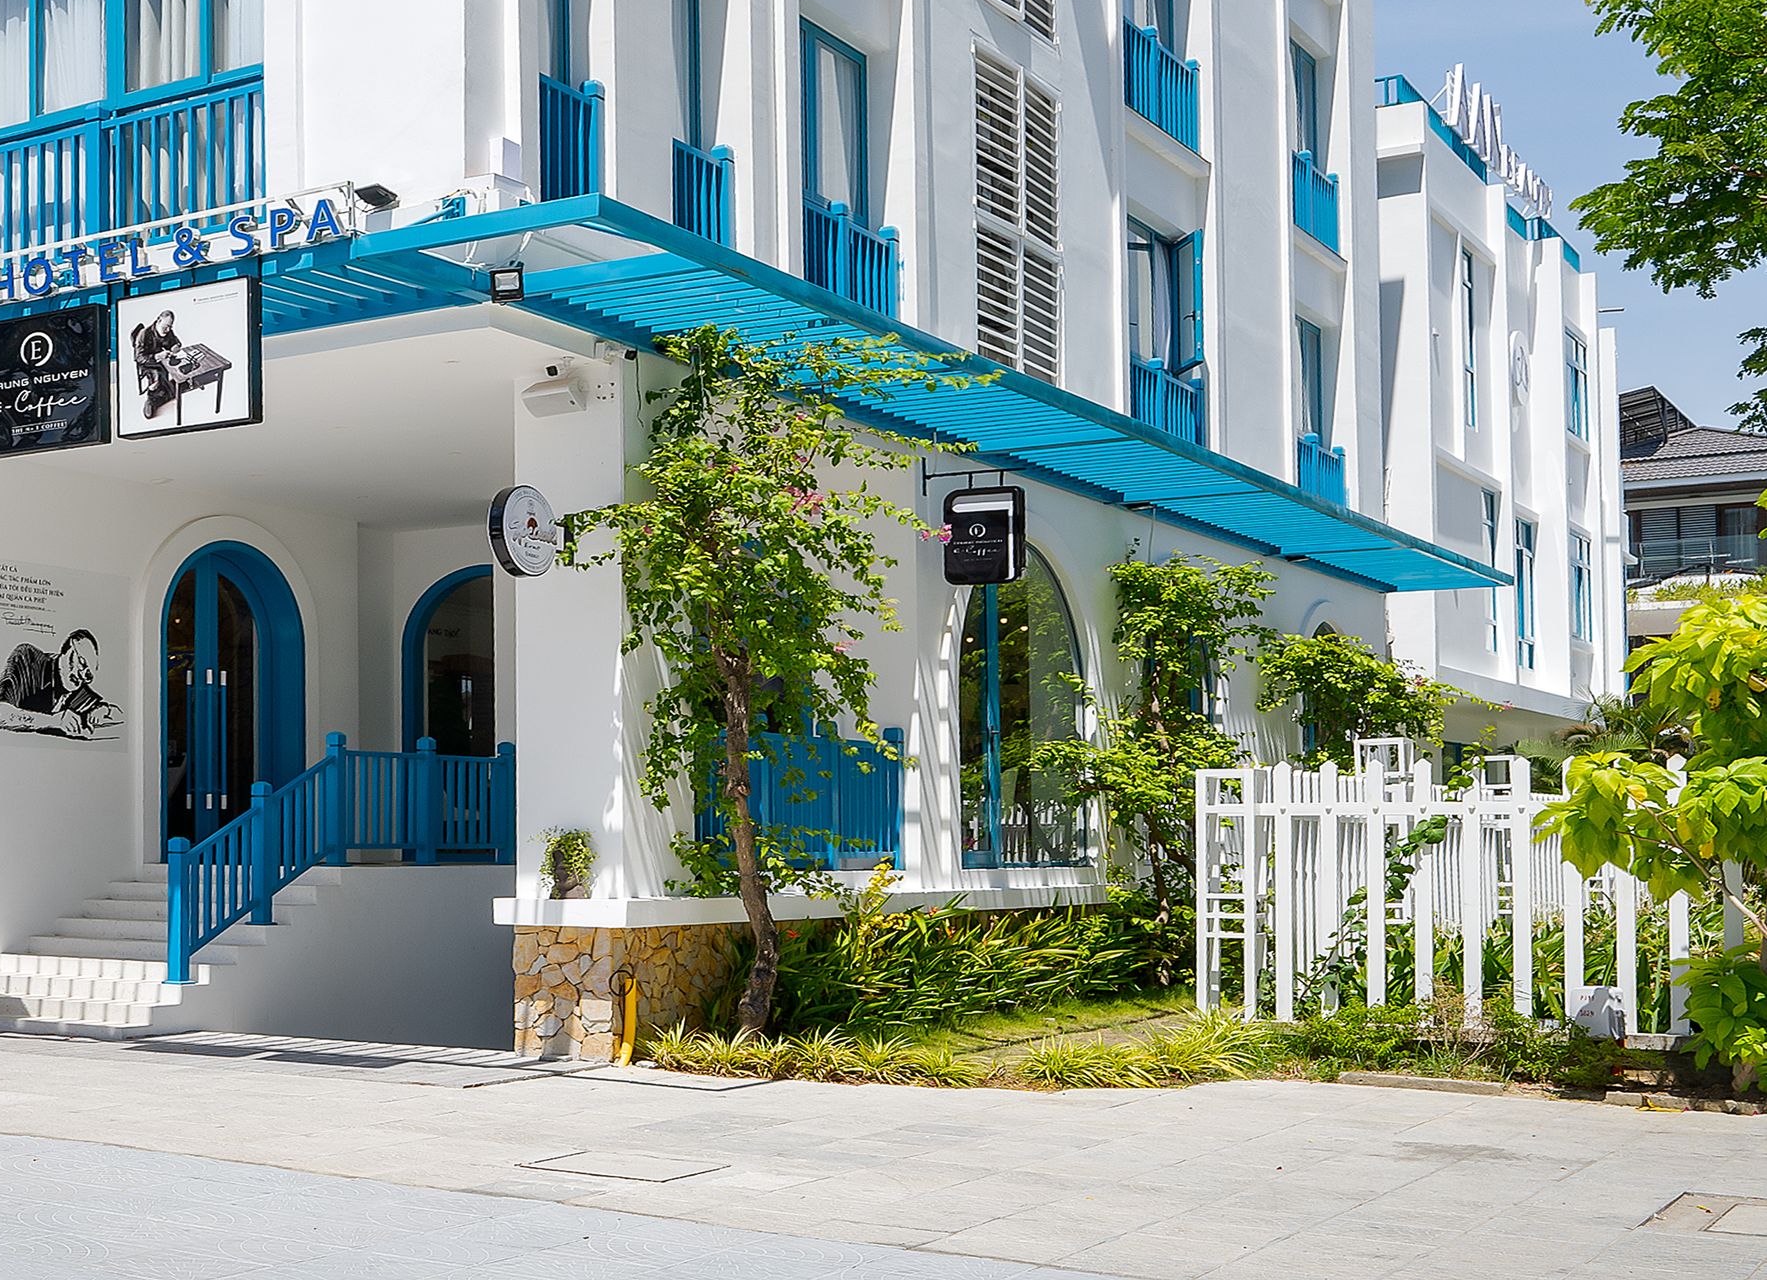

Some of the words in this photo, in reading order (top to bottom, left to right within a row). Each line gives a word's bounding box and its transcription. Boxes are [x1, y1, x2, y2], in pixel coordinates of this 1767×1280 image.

[172, 227, 211, 266] &
[229, 198, 346, 257] SPA
[33, 368, 89, 385] NGUYEN
